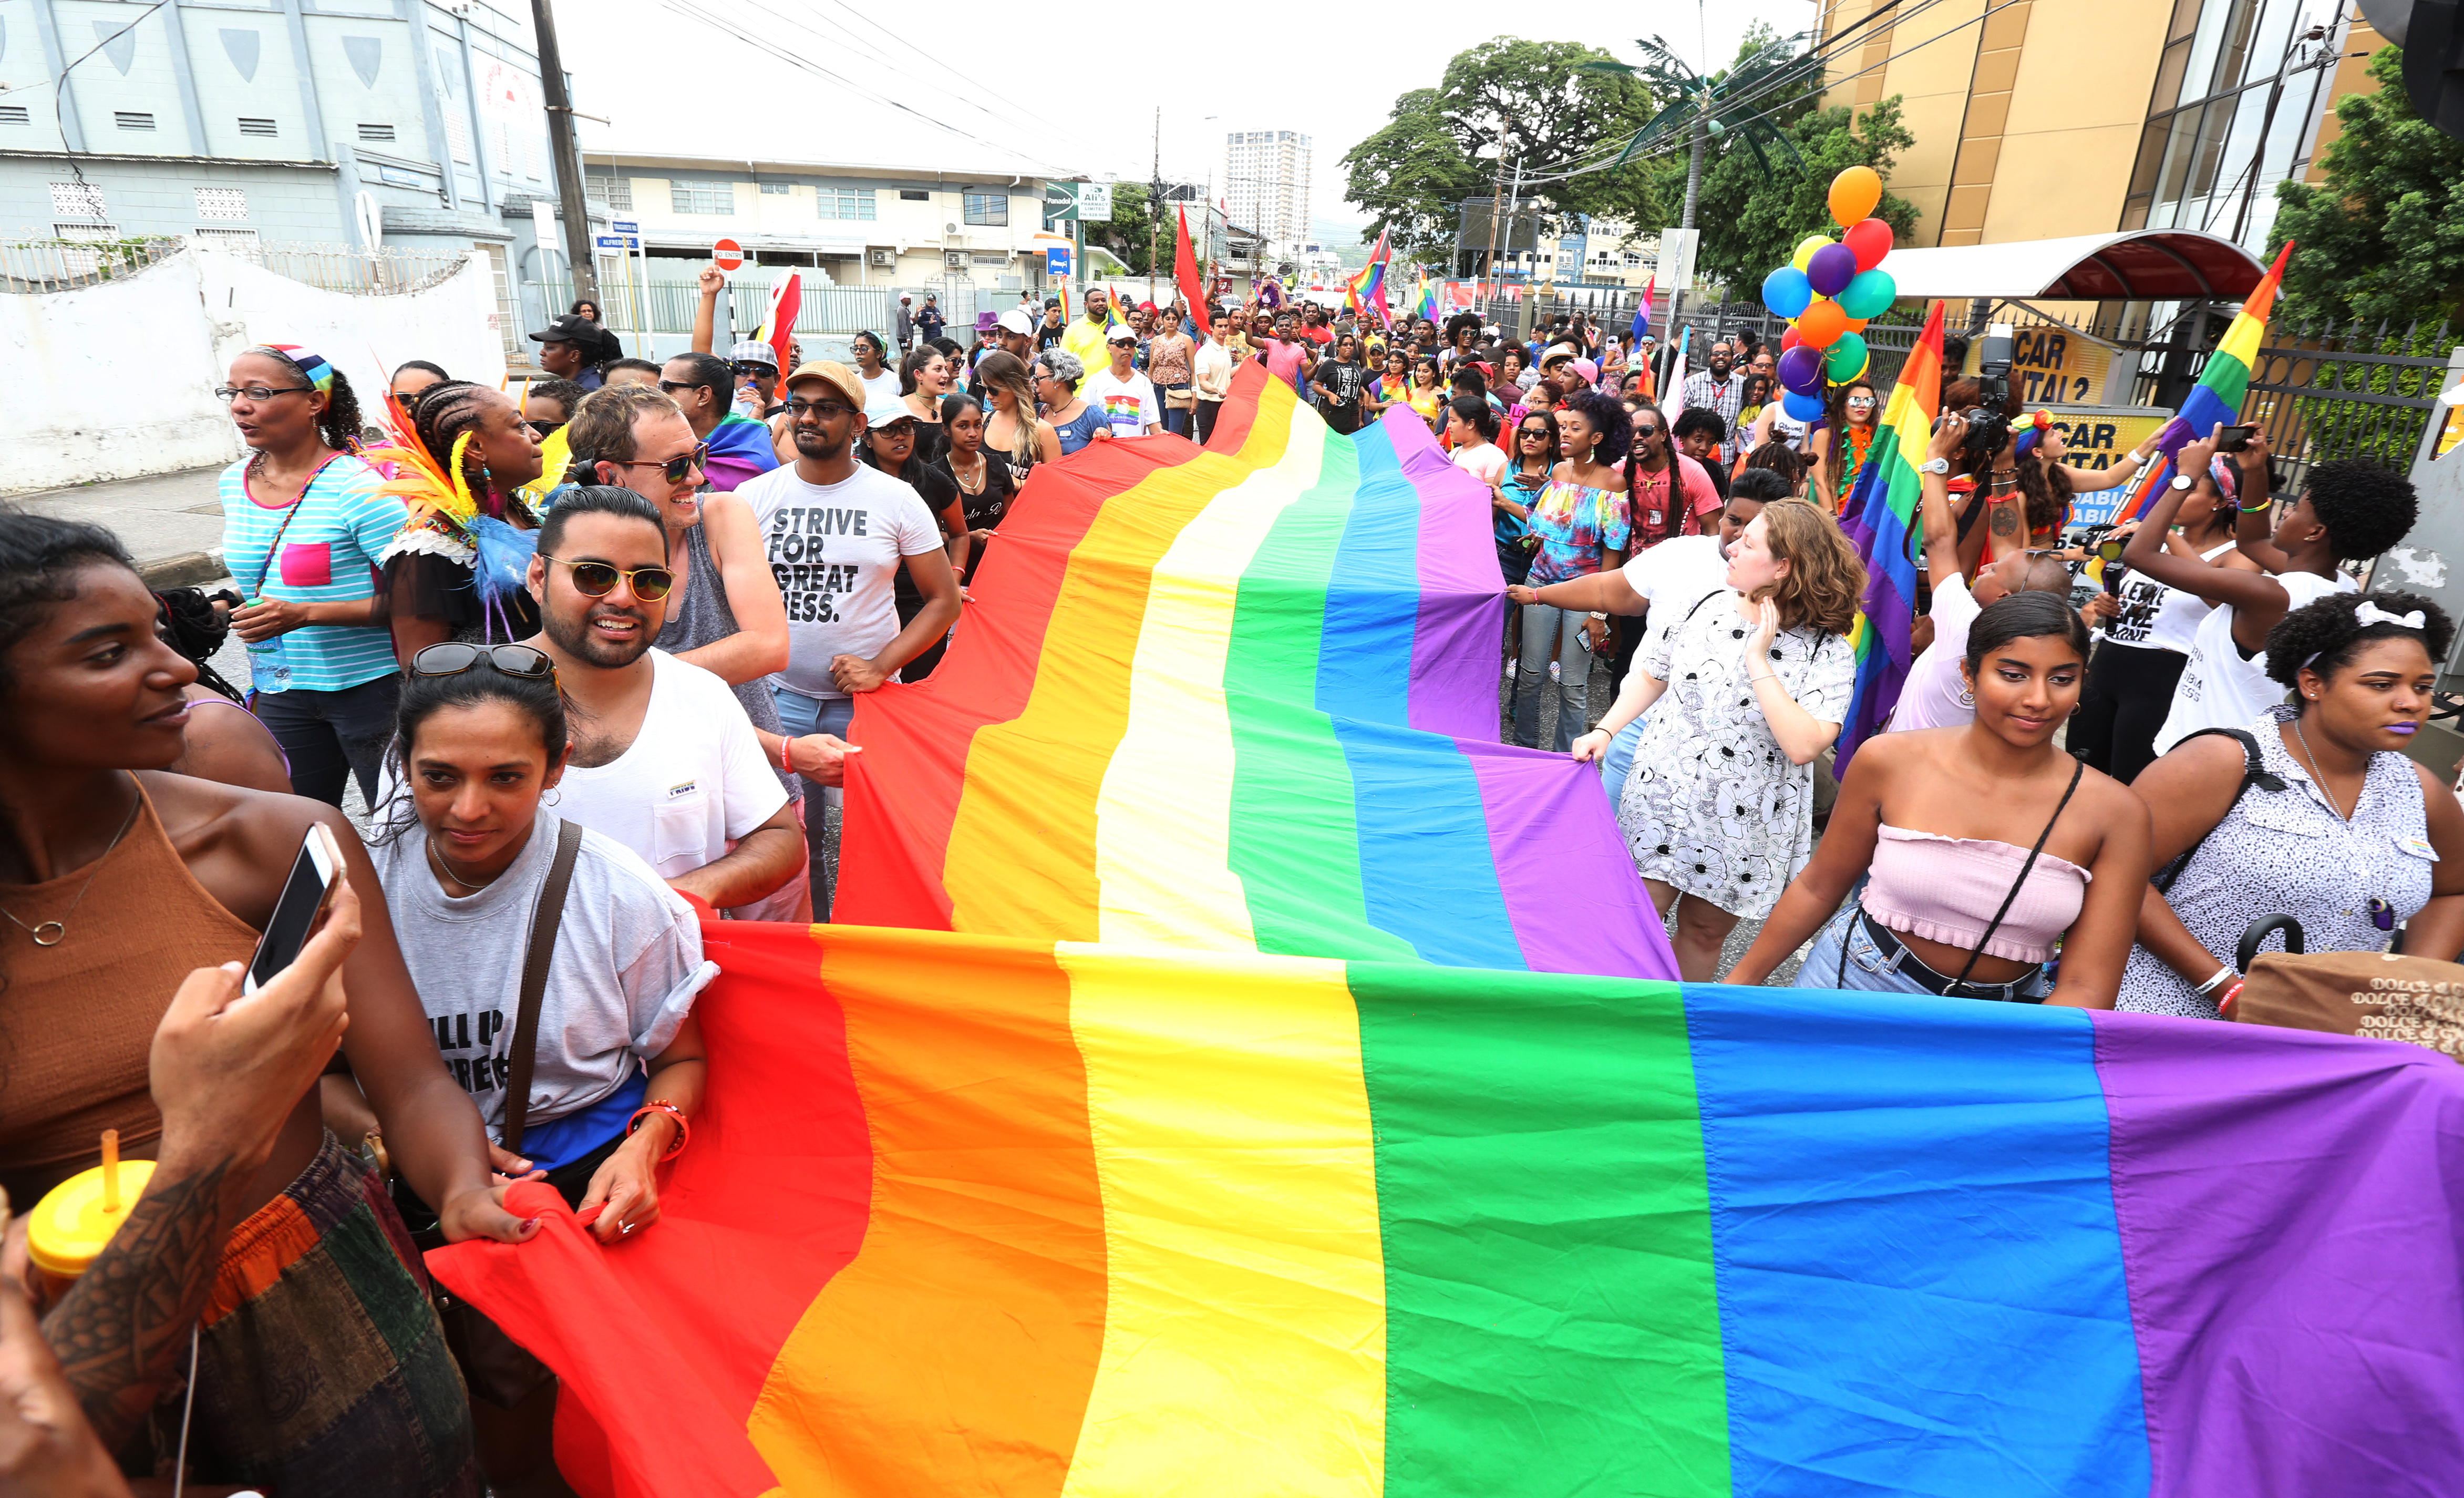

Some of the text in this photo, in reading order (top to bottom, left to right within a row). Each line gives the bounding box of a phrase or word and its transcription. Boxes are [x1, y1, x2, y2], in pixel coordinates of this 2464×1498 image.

[2014, 331, 2066, 370] CAR
[2014, 369, 2089, 403] TAL?
[1779, 422, 1802, 433] Strong
[2052, 422, 2116, 449] CAR
[1005, 463, 1029, 479] VE
[773, 508, 867, 536] STRIVE
[768, 533, 824, 563] FOR
[771, 563, 859, 593] GREAT
[2350, 992, 2411, 1005] DOLCE
[2369, 978, 2432, 993] DOLCE
[2451, 983, 2464, 998] G
[2360, 1015, 2424, 1029] DOLCE
[2355, 1028, 2418, 1042] DOLCE
